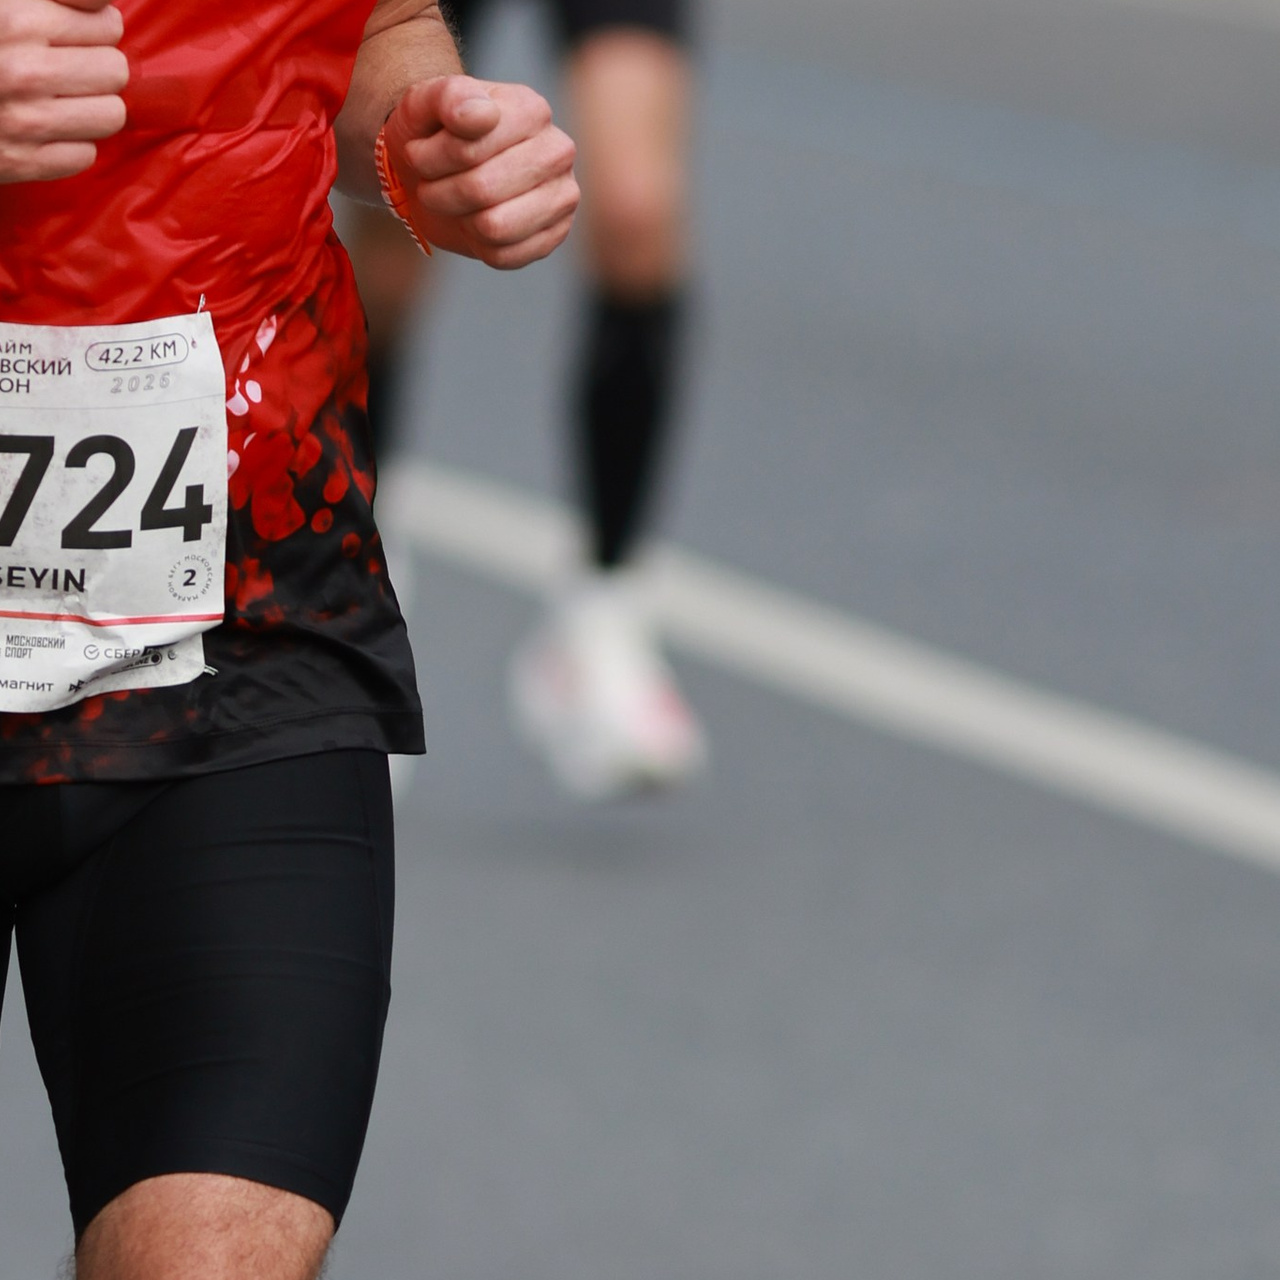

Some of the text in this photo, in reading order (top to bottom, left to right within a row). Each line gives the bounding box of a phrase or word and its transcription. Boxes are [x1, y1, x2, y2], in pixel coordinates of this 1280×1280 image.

[98, 345, 143, 365] 42,2
[110, 372, 170, 394] 2026
[183, 568, 197, 587] 2
[6, 634, 66, 650] МОСКОВСКИЙ
[4, 646, 33, 659] СПОРТ
